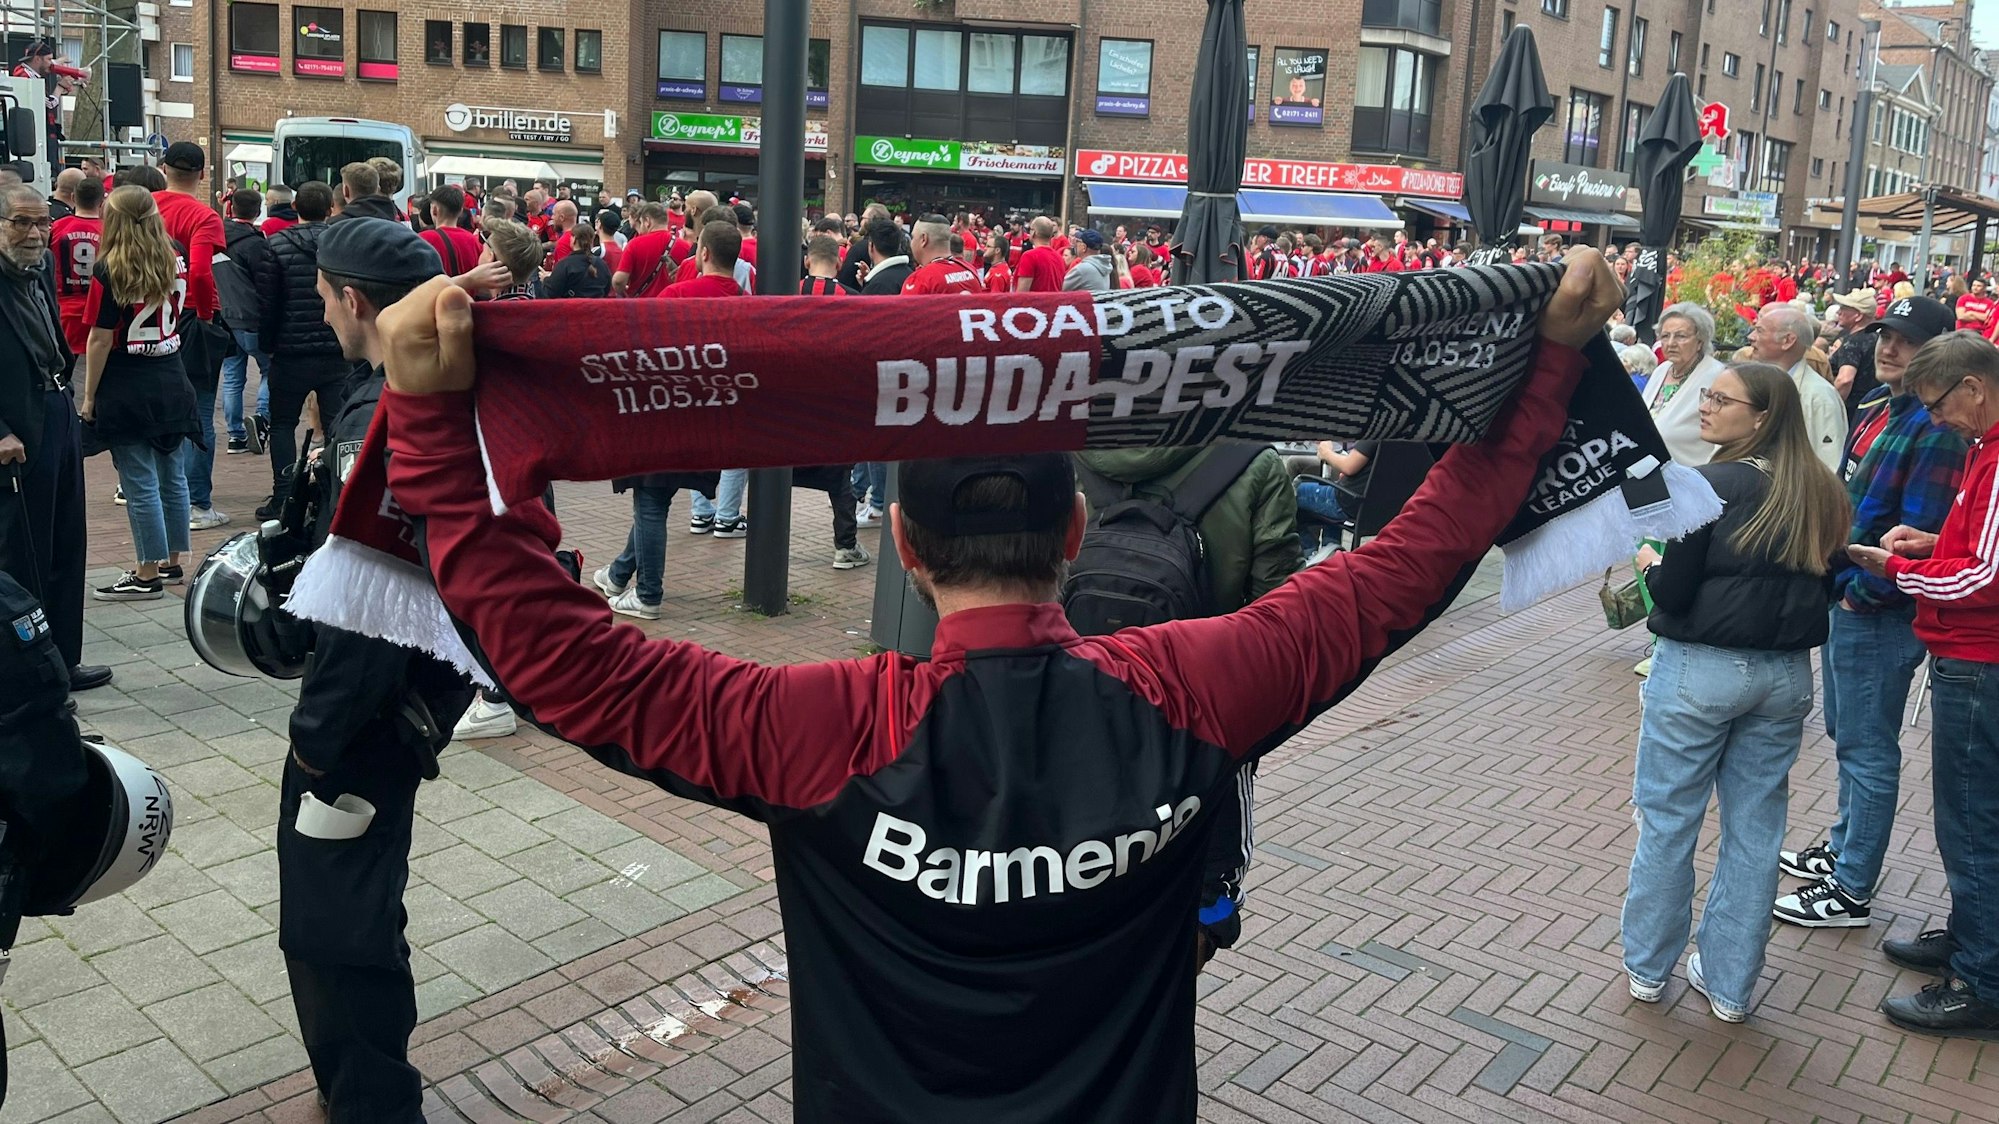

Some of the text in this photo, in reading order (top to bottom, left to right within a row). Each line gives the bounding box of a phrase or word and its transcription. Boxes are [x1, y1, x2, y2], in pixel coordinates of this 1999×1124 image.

[1277, 55, 1323, 66] ALL YOU NEED
[1285, 66, 1293, 74] IS
[476, 109, 571, 132] brillen.de
[658, 114, 736, 138] Zeynep's
[871, 139, 951, 165] Zeynep's
[967, 156, 1057, 171] Frischemarkt
[1119, 156, 1178, 178] PIZZA
[1279, 163, 1340, 187] TREFF
[67, 231, 100, 241] BERBATO
[73, 241, 96, 277] 9
[944, 270, 975, 285] ANDRICH
[958, 295, 1234, 342] ROAD TO
[581, 343, 728, 373] STADIO
[1389, 340, 1496, 369] 18.05.23
[612, 384, 739, 414] 11.05.23
[340, 443, 363, 454] POLIZ
[1530, 429, 1639, 497] ROPA
[1529, 461, 1617, 514] LEAGUE
[137, 796, 160, 856] NRW
